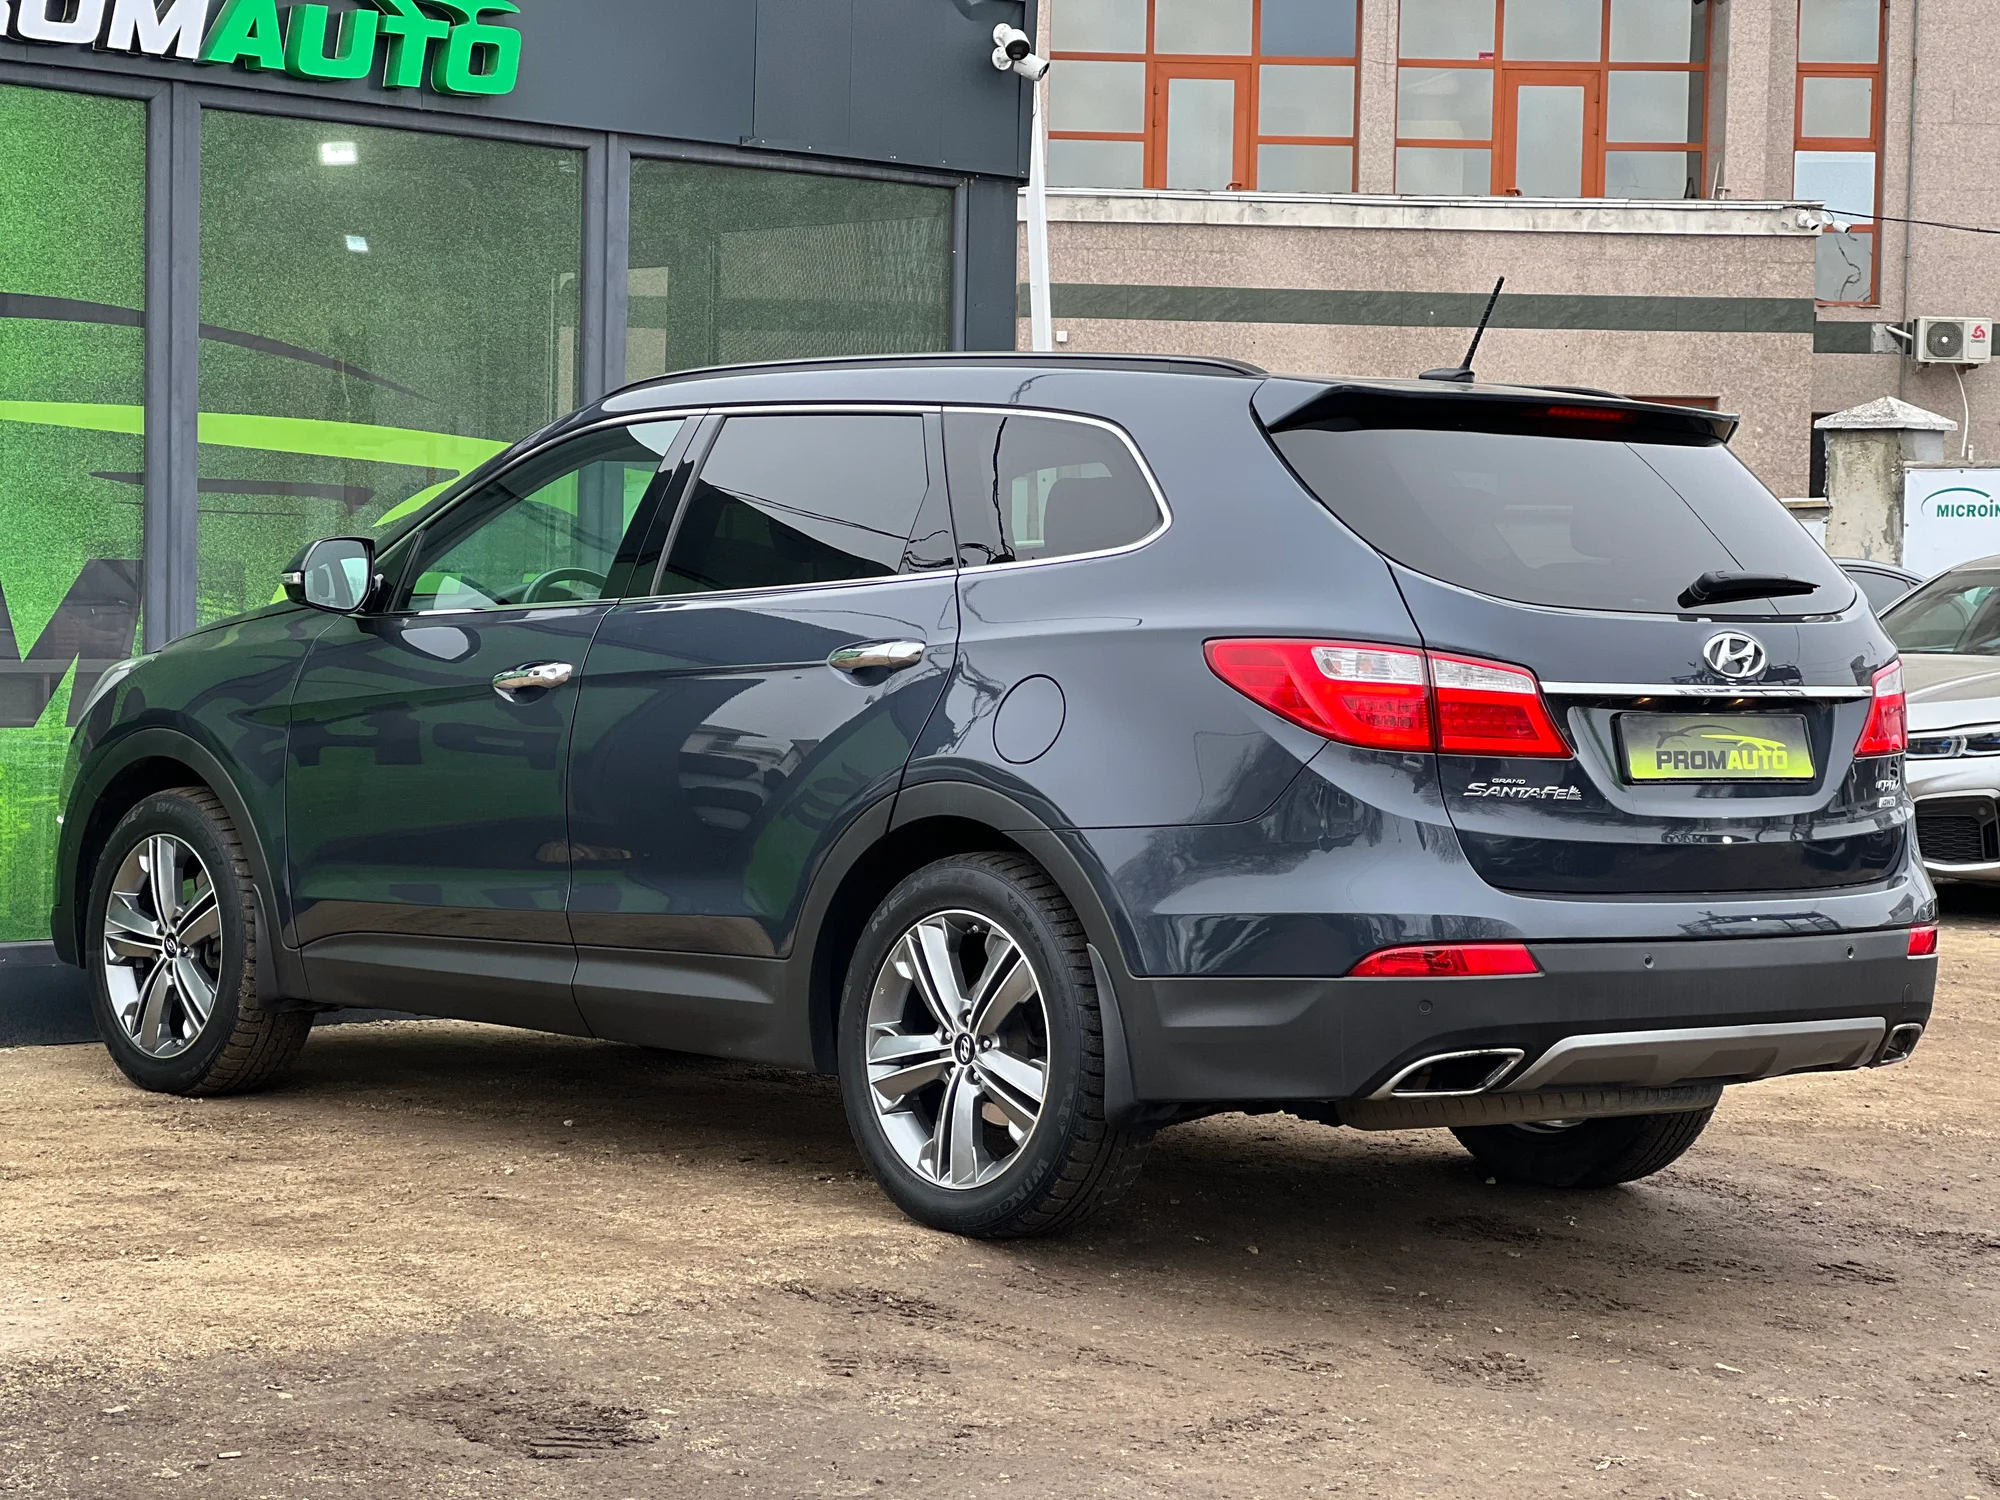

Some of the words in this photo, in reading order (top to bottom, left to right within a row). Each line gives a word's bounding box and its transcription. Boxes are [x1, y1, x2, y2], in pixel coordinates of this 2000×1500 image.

[0, 0, 522, 95] OMAUTO
[1656, 750, 1788, 770] PROMAUTO
[1491, 777, 1526, 785] GRAND
